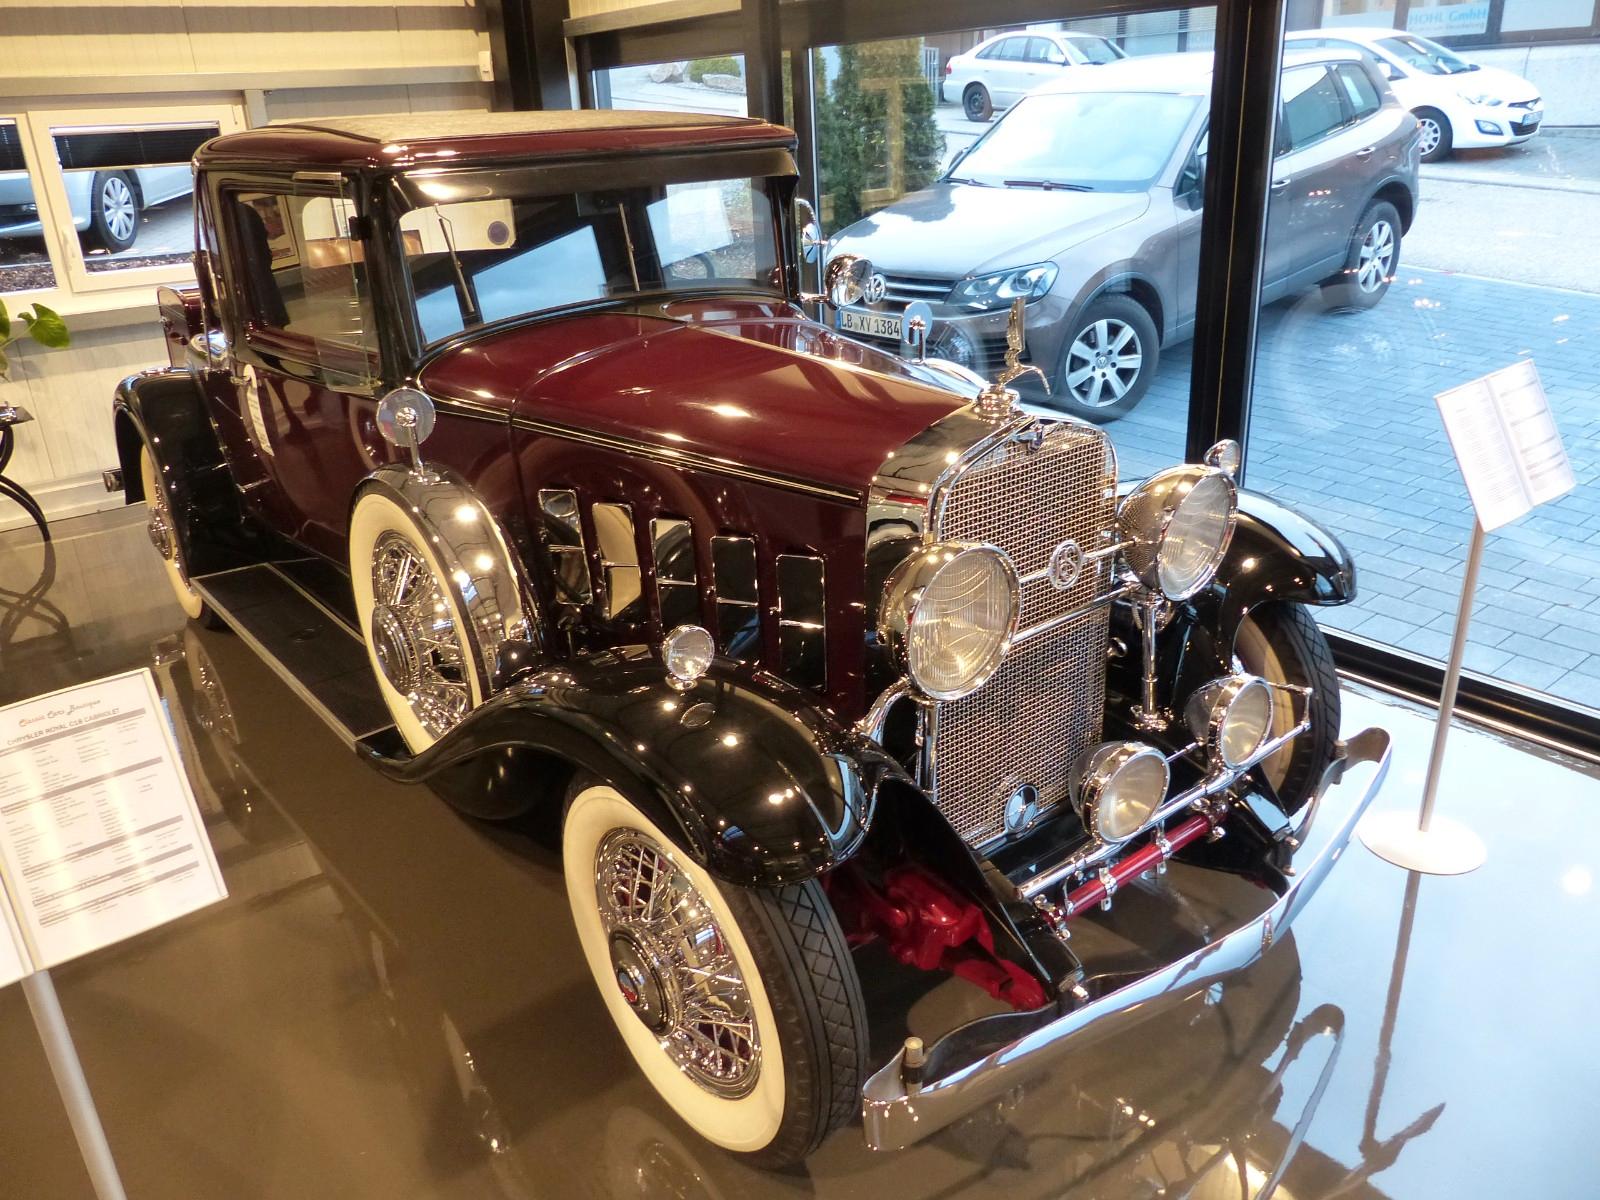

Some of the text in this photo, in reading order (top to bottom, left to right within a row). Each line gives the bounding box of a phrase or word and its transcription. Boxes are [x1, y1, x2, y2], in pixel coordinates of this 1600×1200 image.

[1448, 8, 1487, 22] GmbH
[841, 311, 900, 337] LB XY 1384
[7, 730, 44, 746] CHRYSLER
